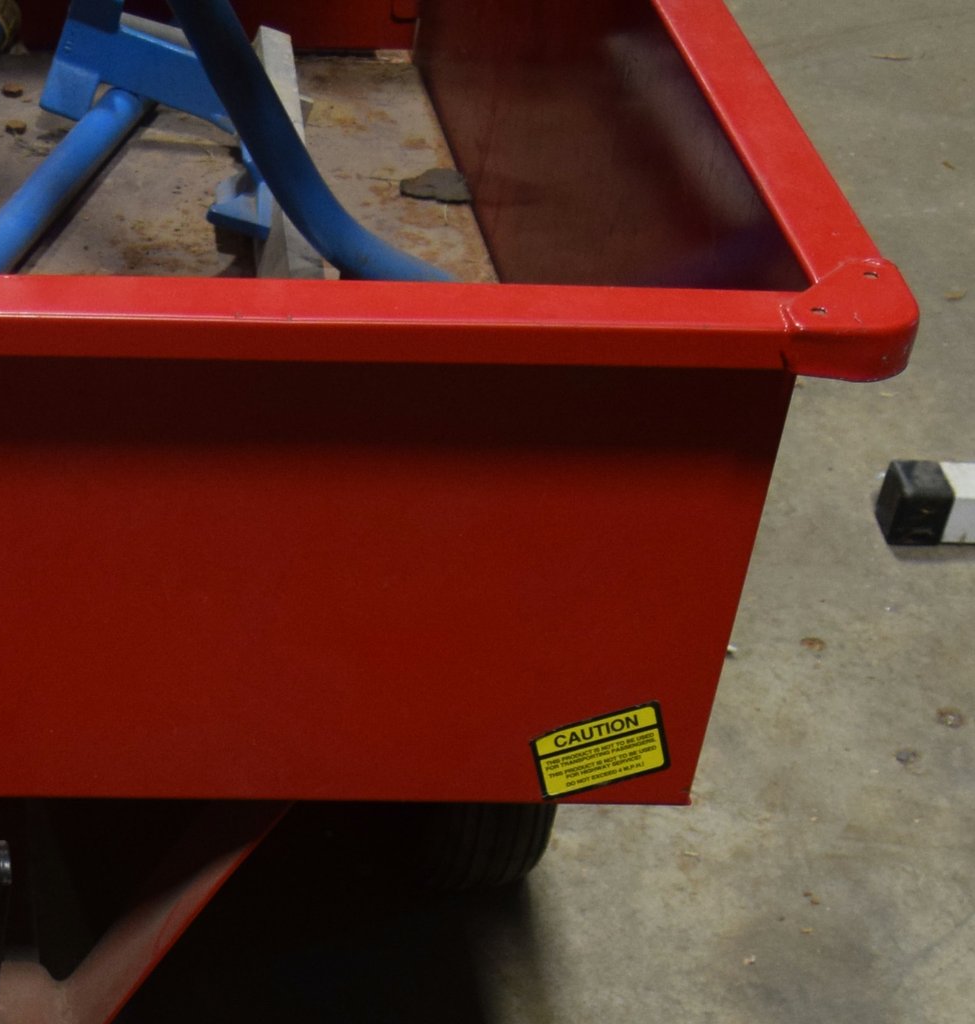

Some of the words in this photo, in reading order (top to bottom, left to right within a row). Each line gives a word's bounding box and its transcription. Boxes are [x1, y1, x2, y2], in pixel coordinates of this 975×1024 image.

[554, 715, 639, 747] CAUTION
[561, 750, 610, 768] TRANSPORTING
[562, 750, 592, 762] PRODUCT
[636, 733, 654, 741] USED
[564, 763, 595, 774] PRODUCT
[639, 745, 656, 754] USED
[583, 764, 610, 776] HIGHWAY
[592, 770, 617, 780] EXCEED
